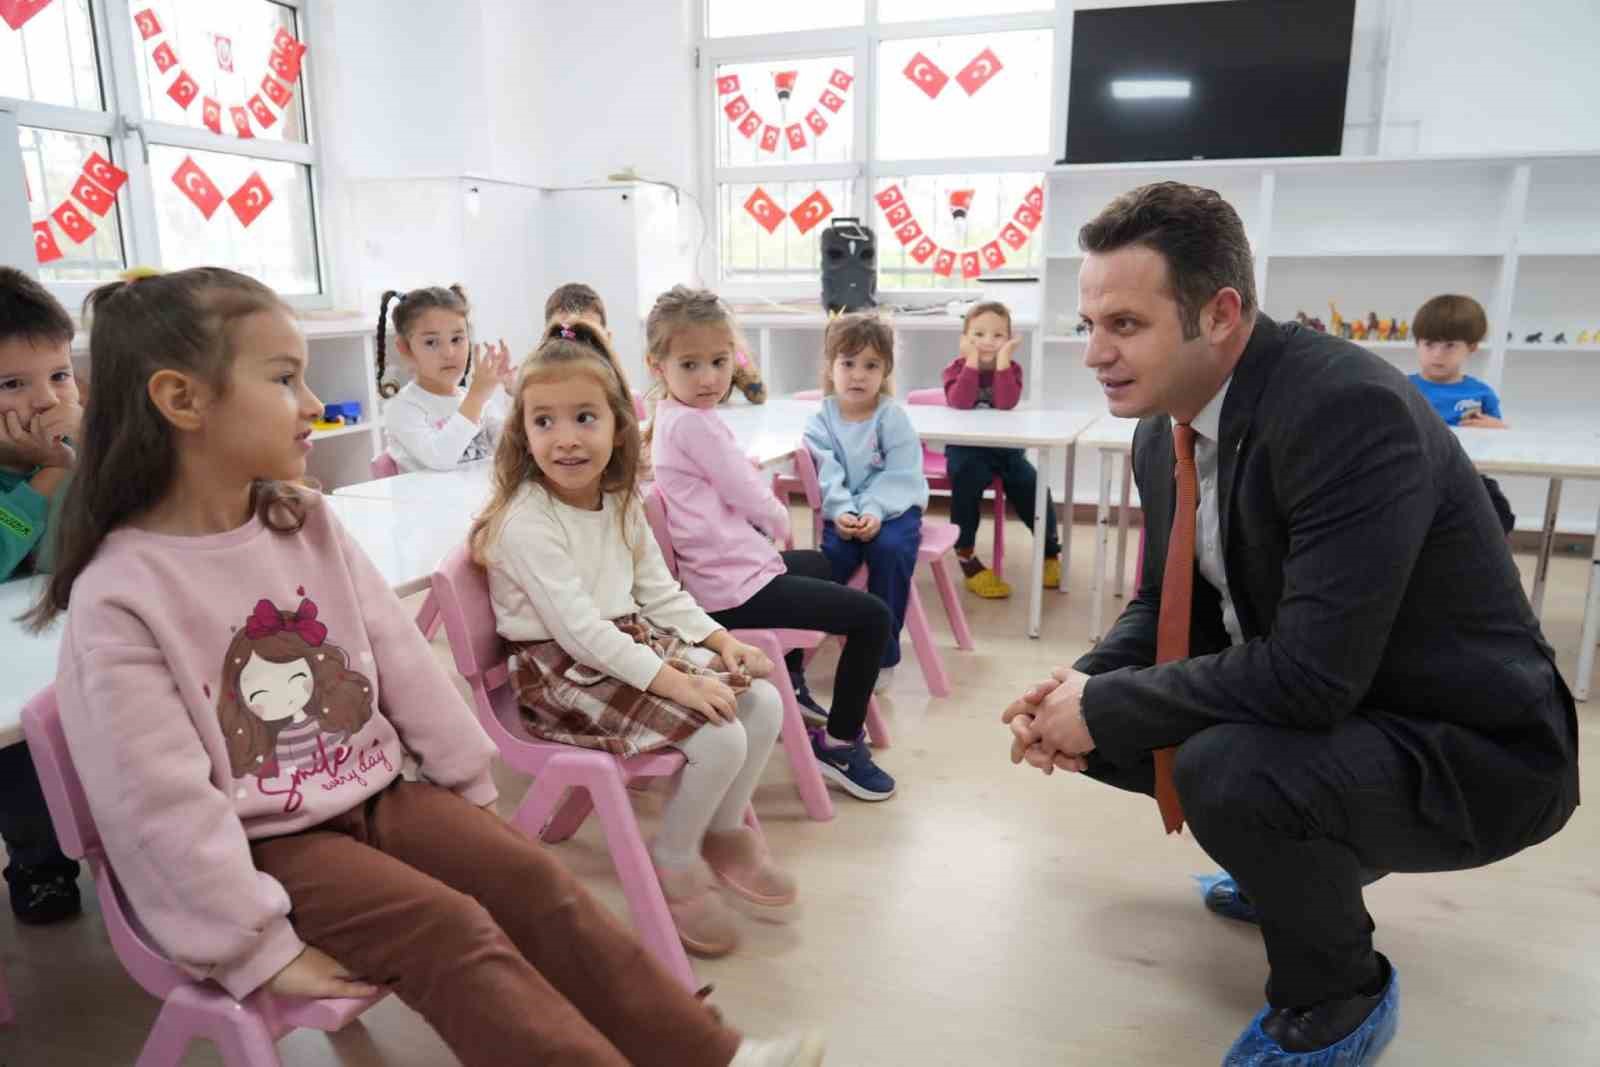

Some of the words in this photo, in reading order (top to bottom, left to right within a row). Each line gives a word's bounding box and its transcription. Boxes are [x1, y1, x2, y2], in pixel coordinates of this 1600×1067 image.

[257, 734, 353, 812] Smile
[321, 769, 368, 791] every
[358, 749, 392, 773] day
